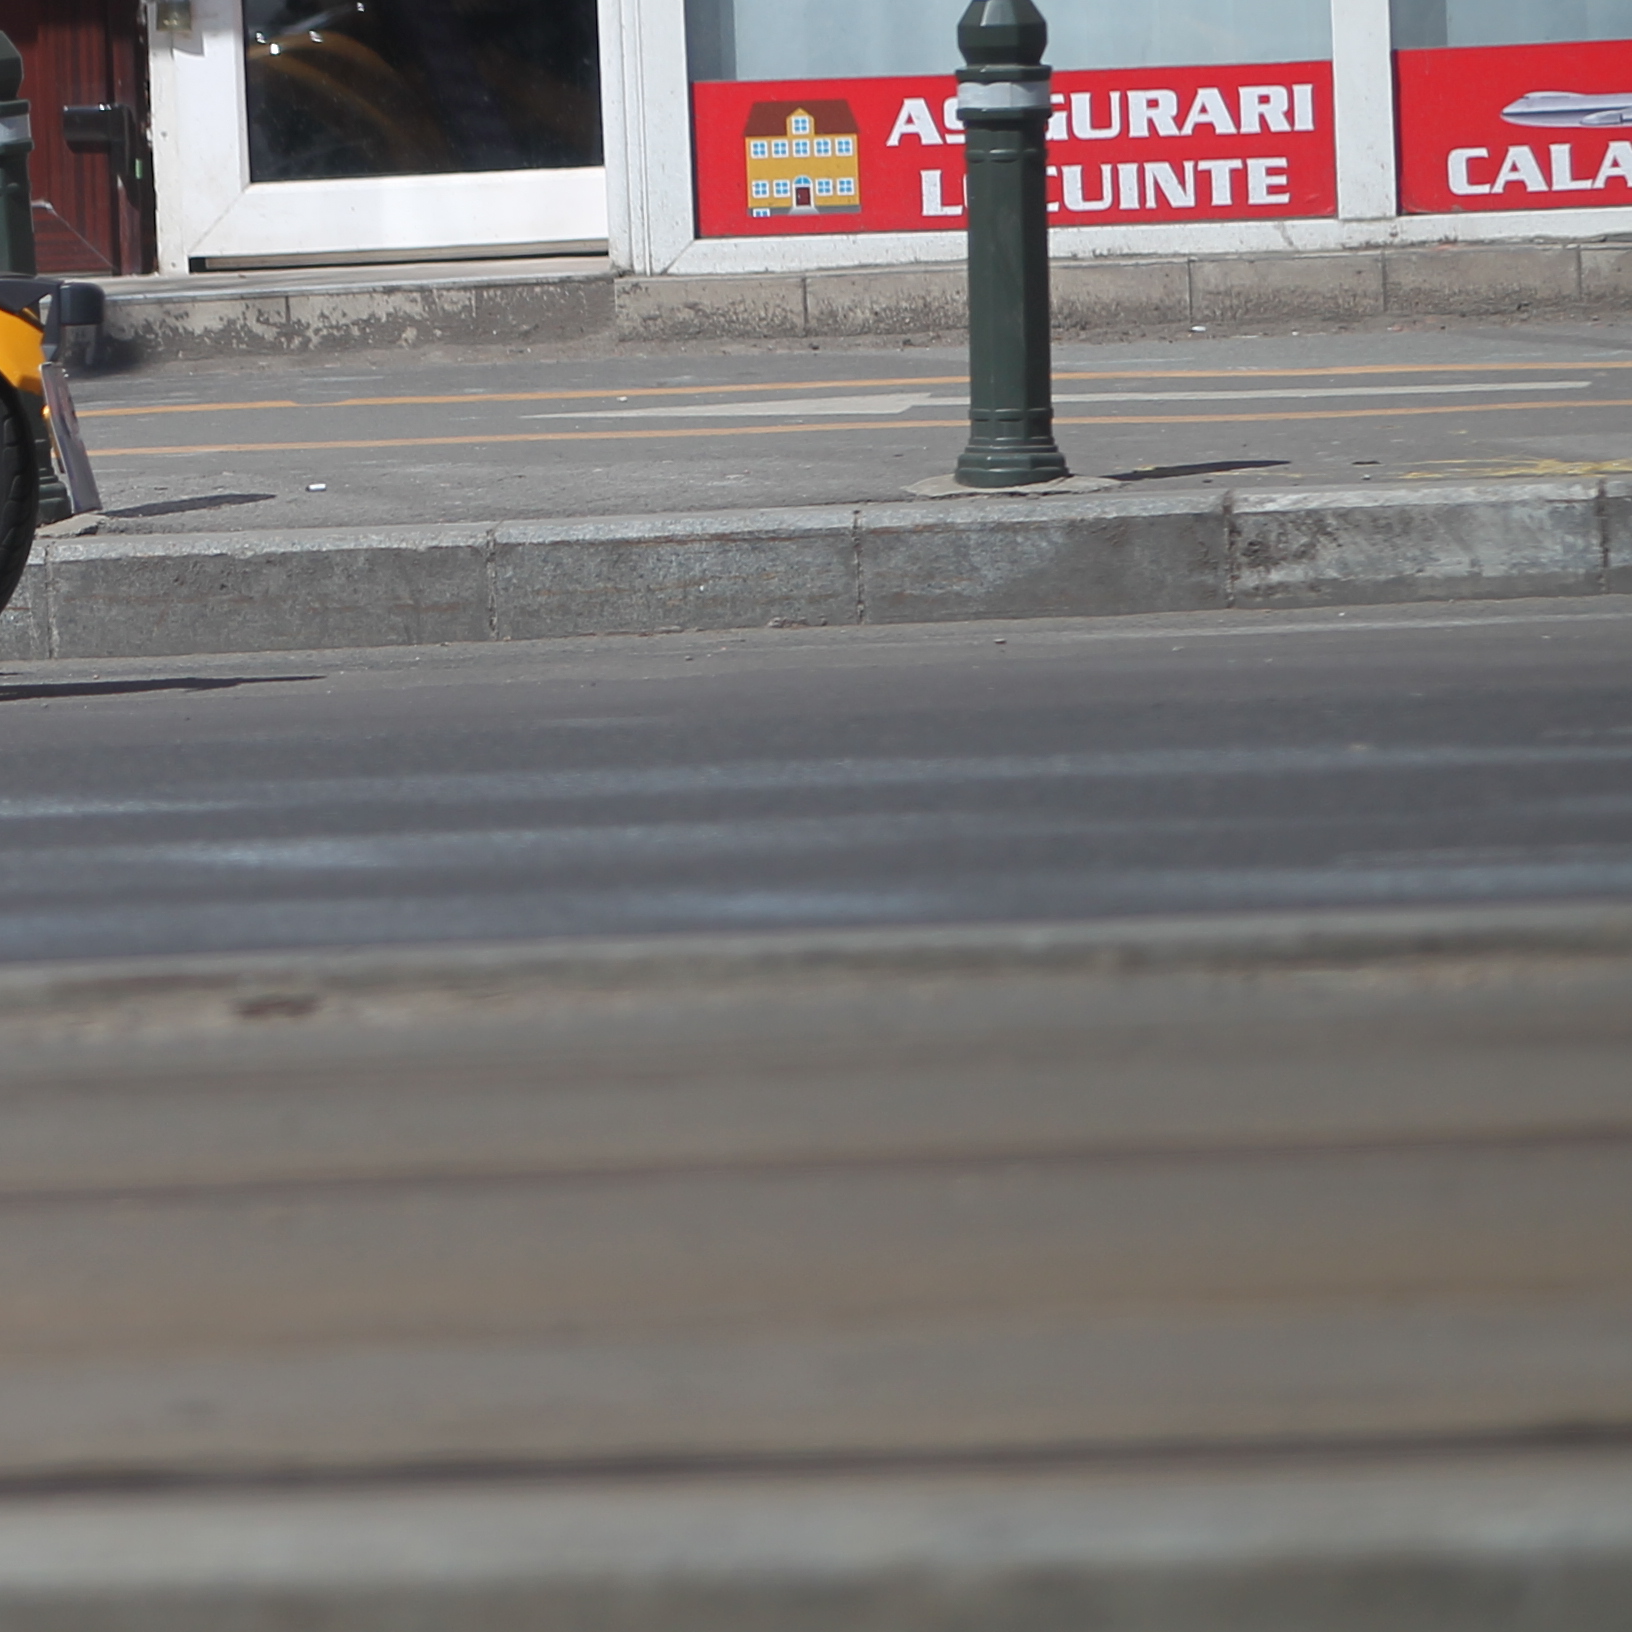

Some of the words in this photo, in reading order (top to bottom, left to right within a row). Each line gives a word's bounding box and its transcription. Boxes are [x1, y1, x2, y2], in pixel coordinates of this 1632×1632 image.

[886, 83, 1315, 147] AURARI
[920, 157, 1291, 217] LUINTE
[1447, 140, 1632, 196] CALA
